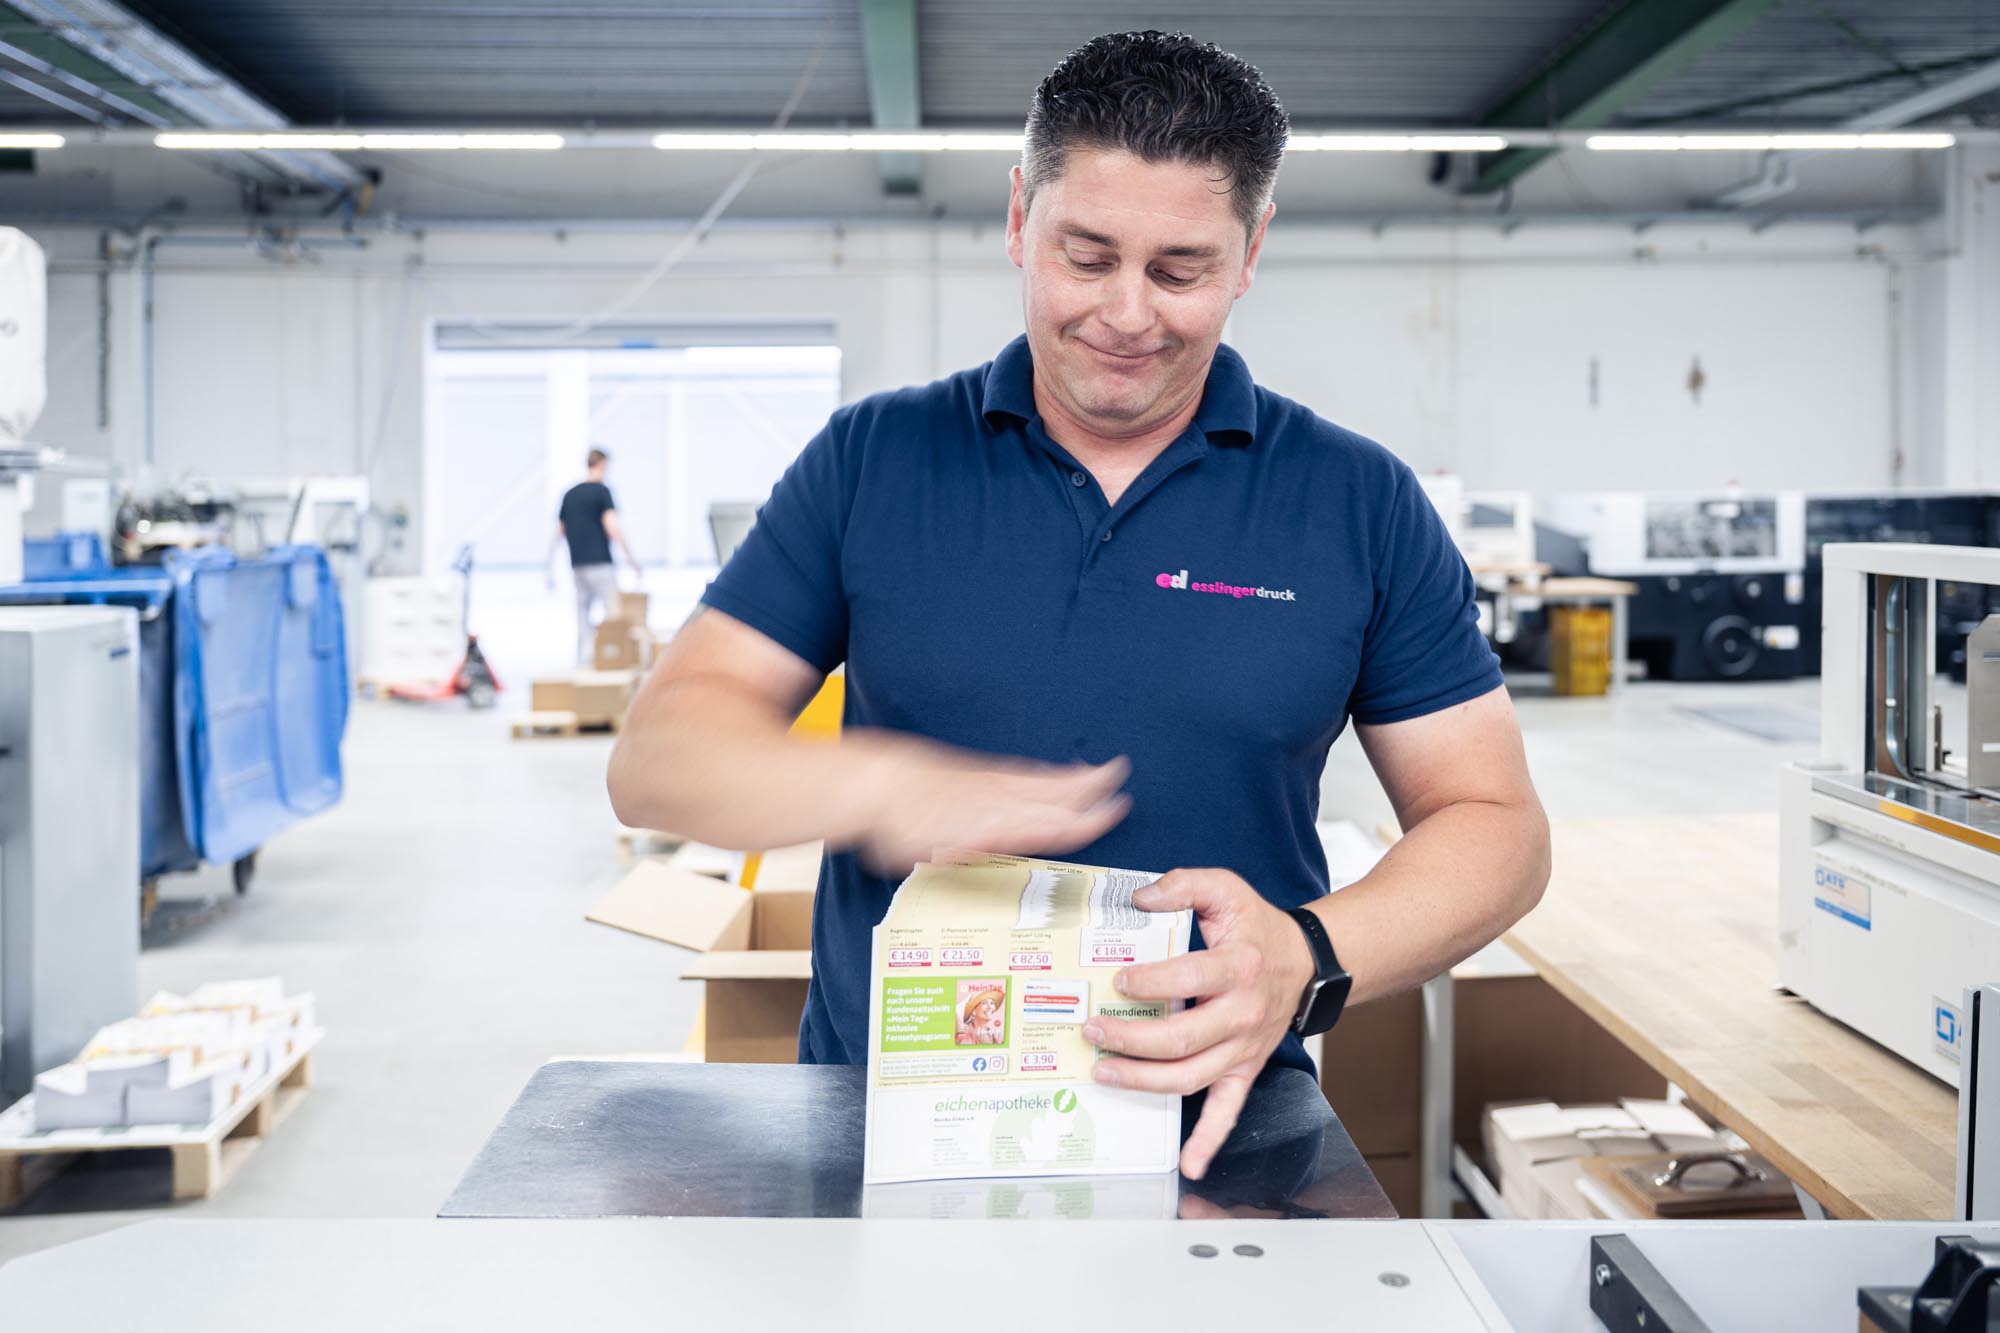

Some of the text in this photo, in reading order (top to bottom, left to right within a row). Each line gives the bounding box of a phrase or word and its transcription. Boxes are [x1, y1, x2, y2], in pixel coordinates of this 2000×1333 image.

[1191, 581, 1296, 601] esslingerdruck
[891, 951, 898, 960] €
[942, 950, 949, 960] €
[1095, 947, 1102, 956] €
[1011, 954, 1019, 964] €
[1100, 1007, 1160, 1017] Botendienst:
[1023, 1055, 1030, 1064] €
[934, 1095, 1052, 1113] eichenapotheke
